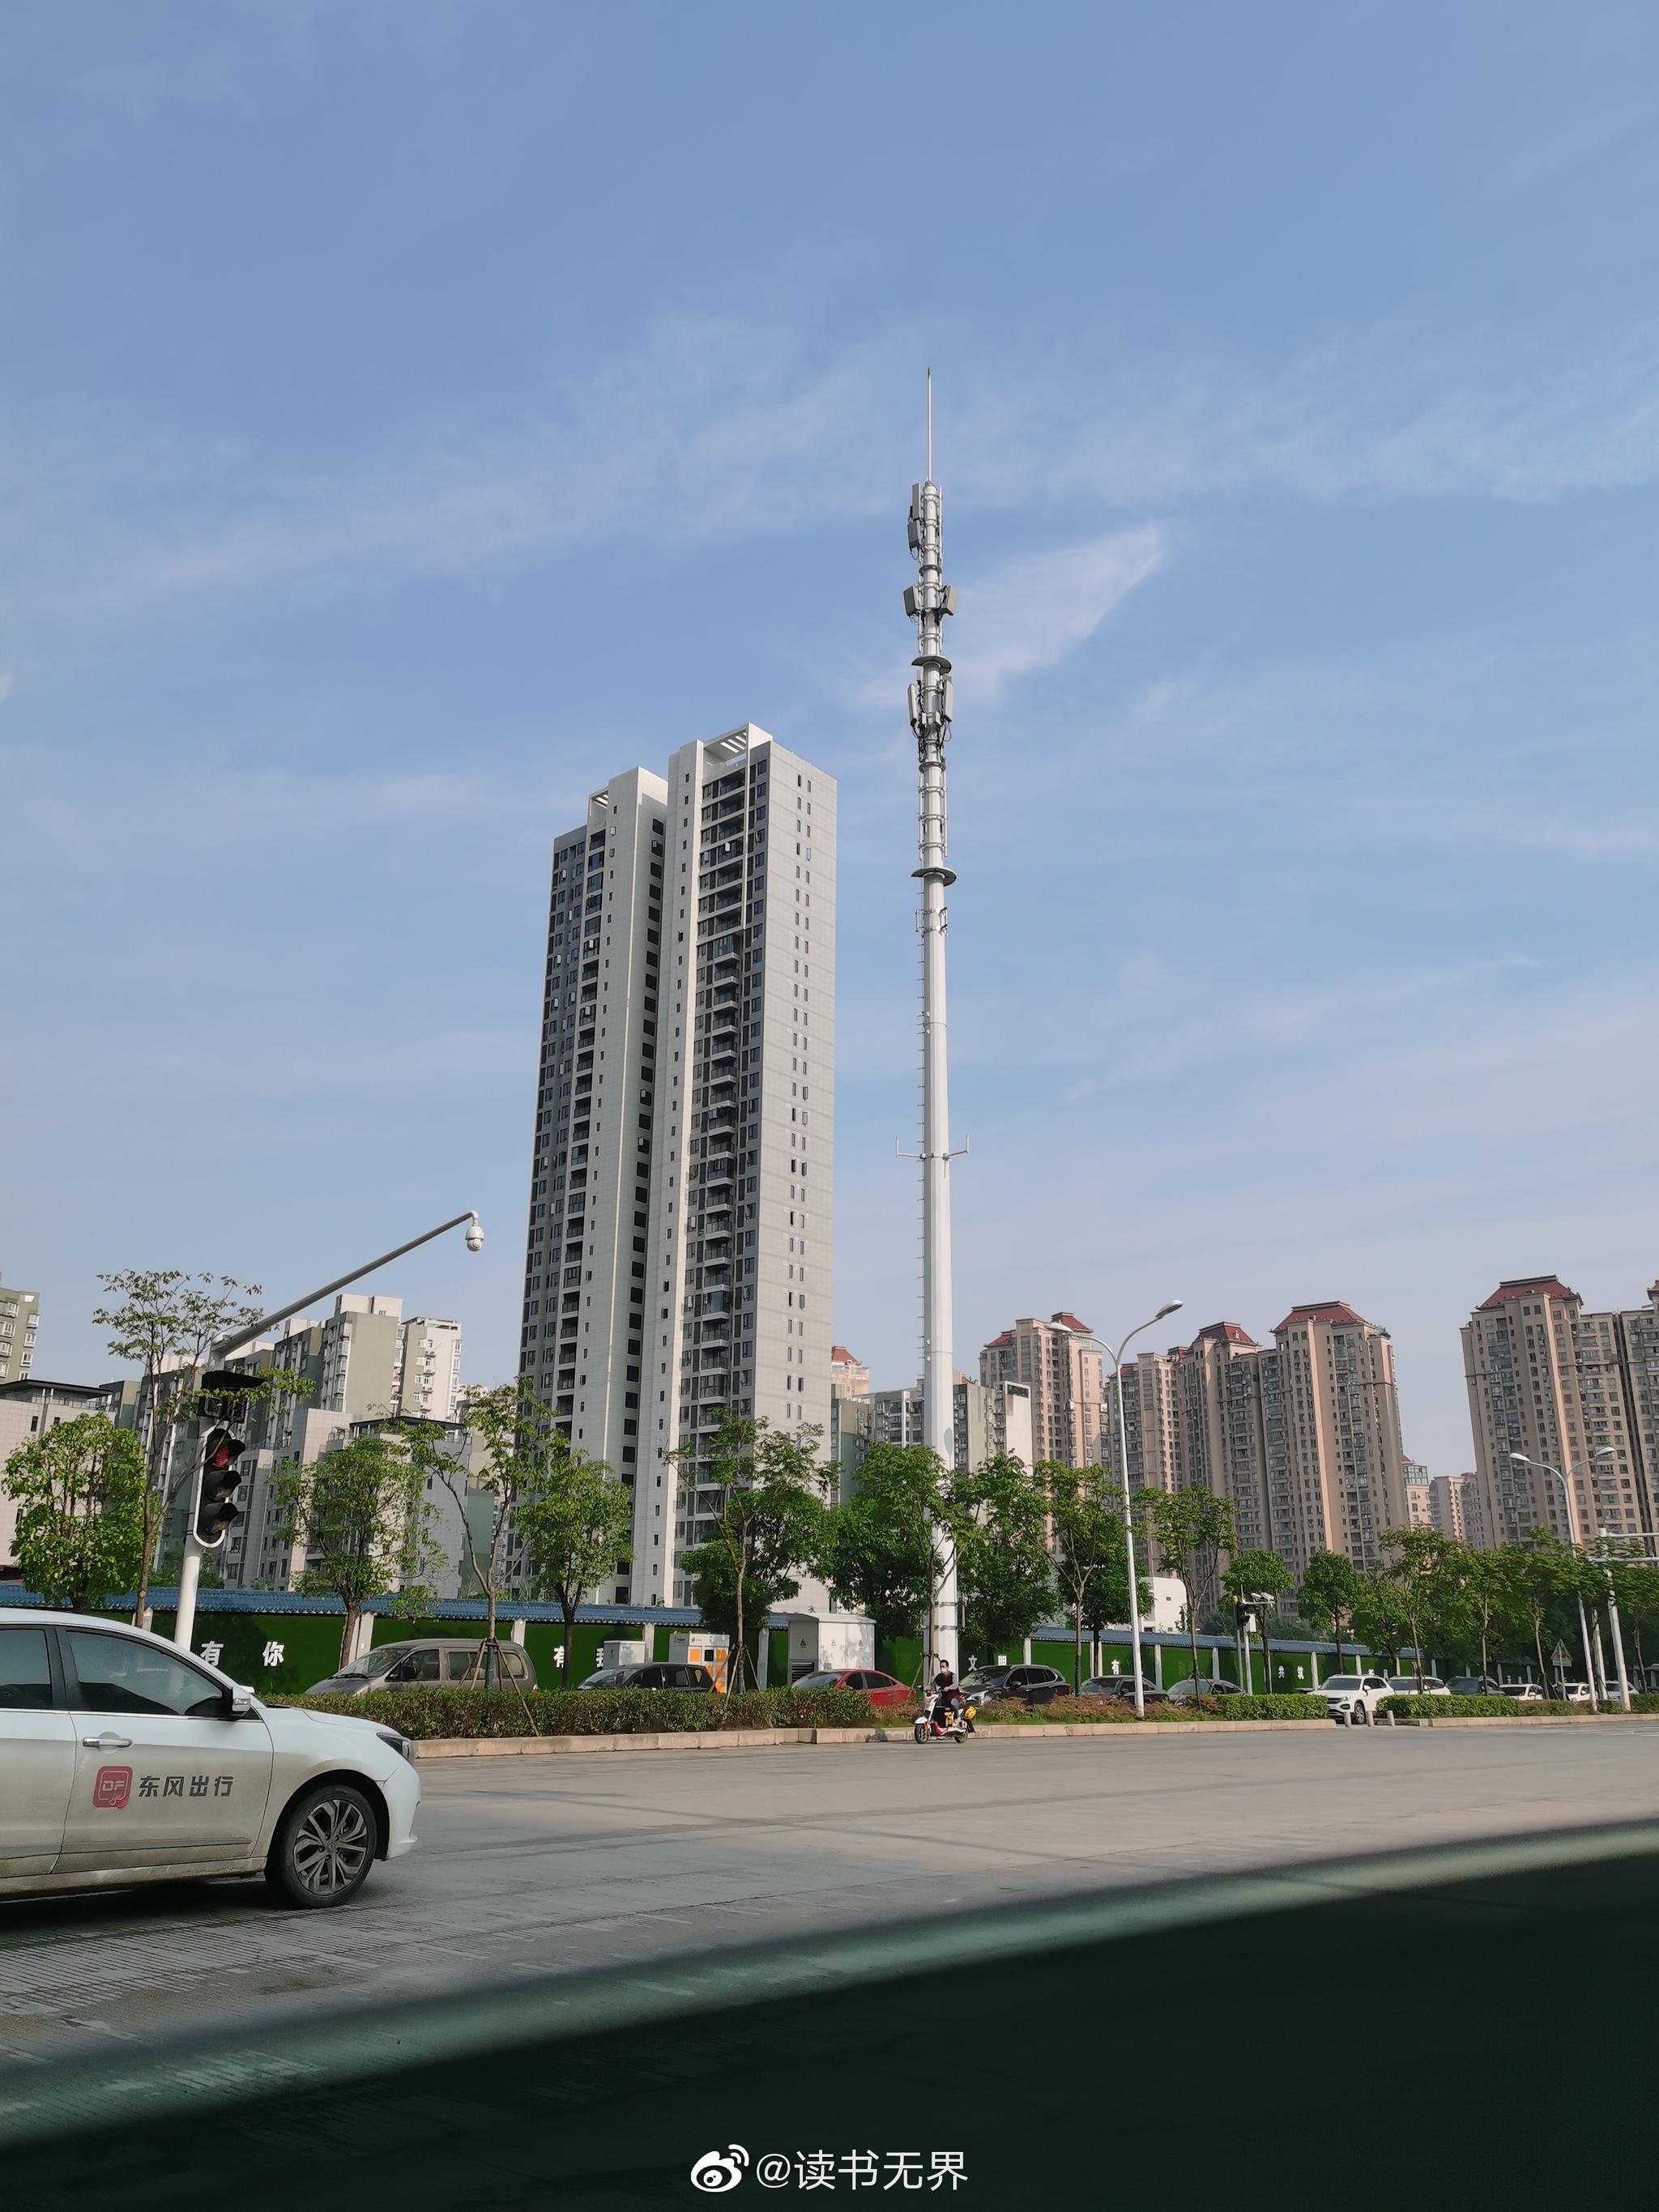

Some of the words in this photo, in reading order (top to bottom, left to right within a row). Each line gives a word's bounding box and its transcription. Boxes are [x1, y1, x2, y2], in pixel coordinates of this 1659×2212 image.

[102, 1780, 126, 1792] DF
[138, 1775, 234, 1797] 东风出行
